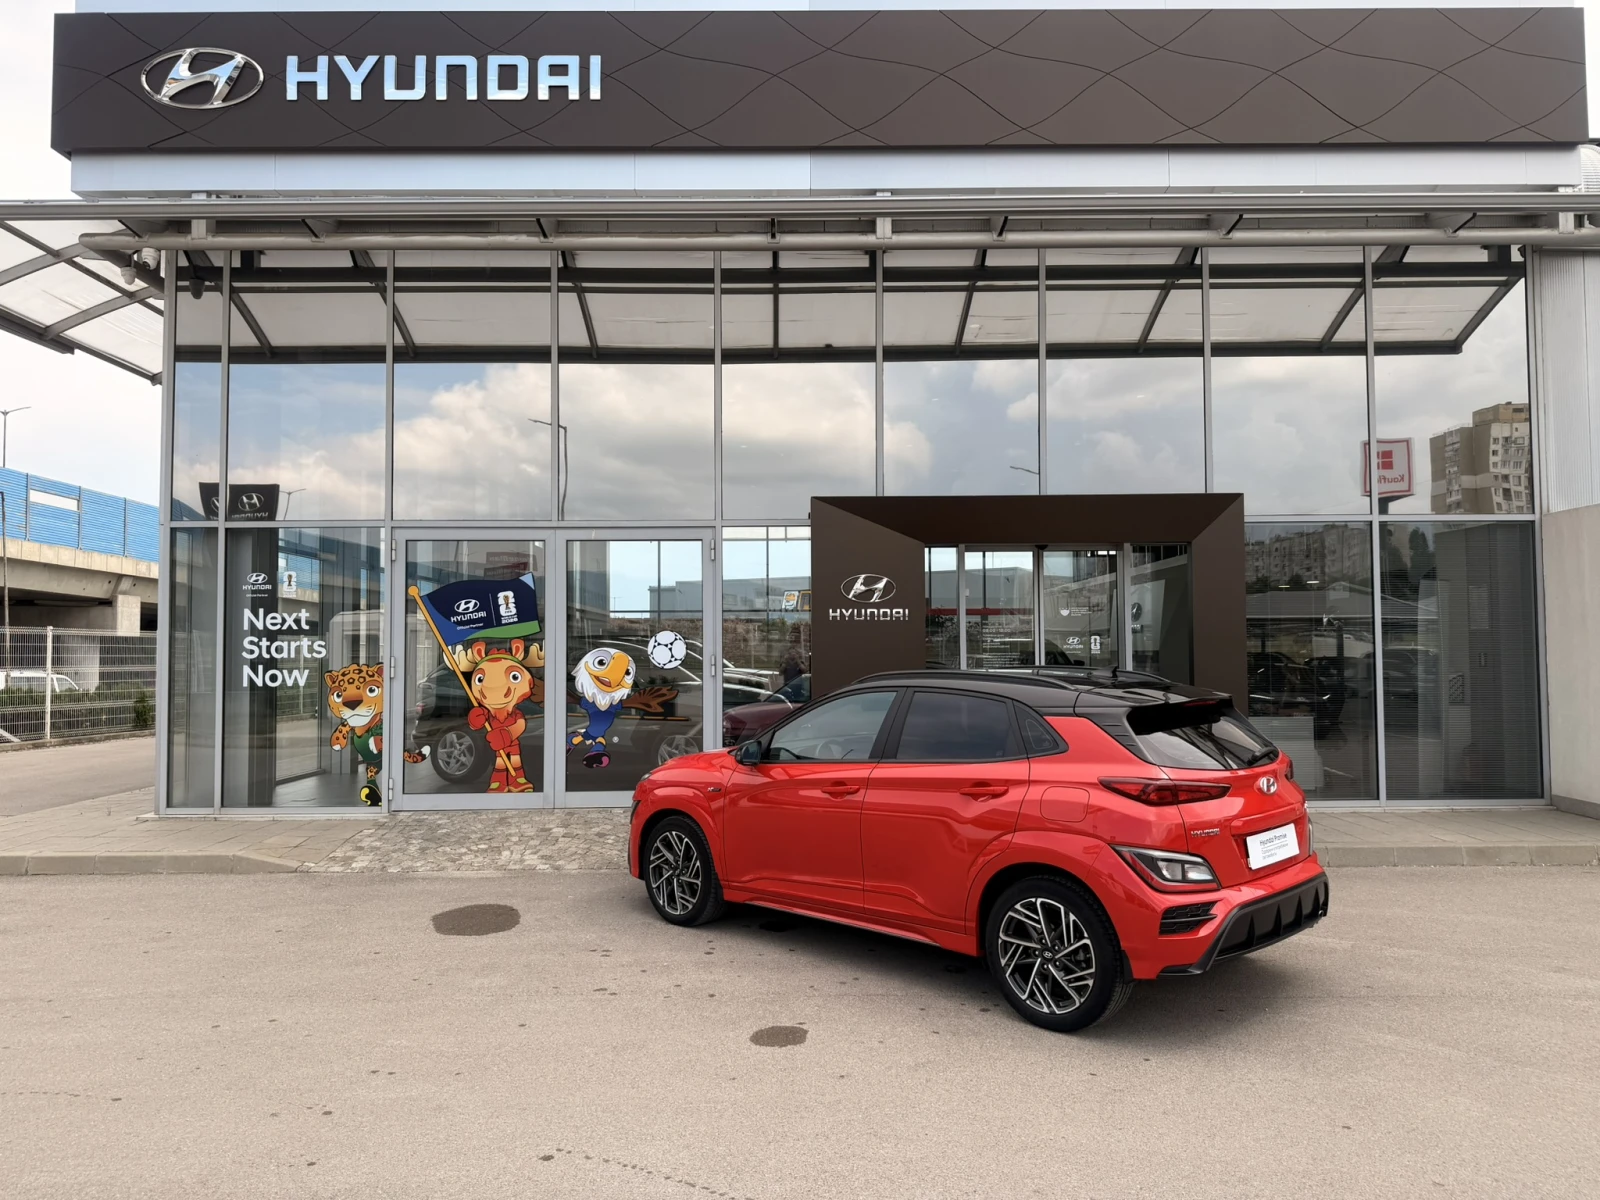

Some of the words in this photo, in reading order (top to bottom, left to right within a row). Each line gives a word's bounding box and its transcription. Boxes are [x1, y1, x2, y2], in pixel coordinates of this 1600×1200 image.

[286, 55, 601, 100] HYUNDAI
[243, 608, 310, 630] Next
[451, 611, 487, 623] HYUNDAI
[829, 608, 909, 620] HYUNDAI
[241, 636, 327, 659] Starts
[242, 665, 309, 687] Now
